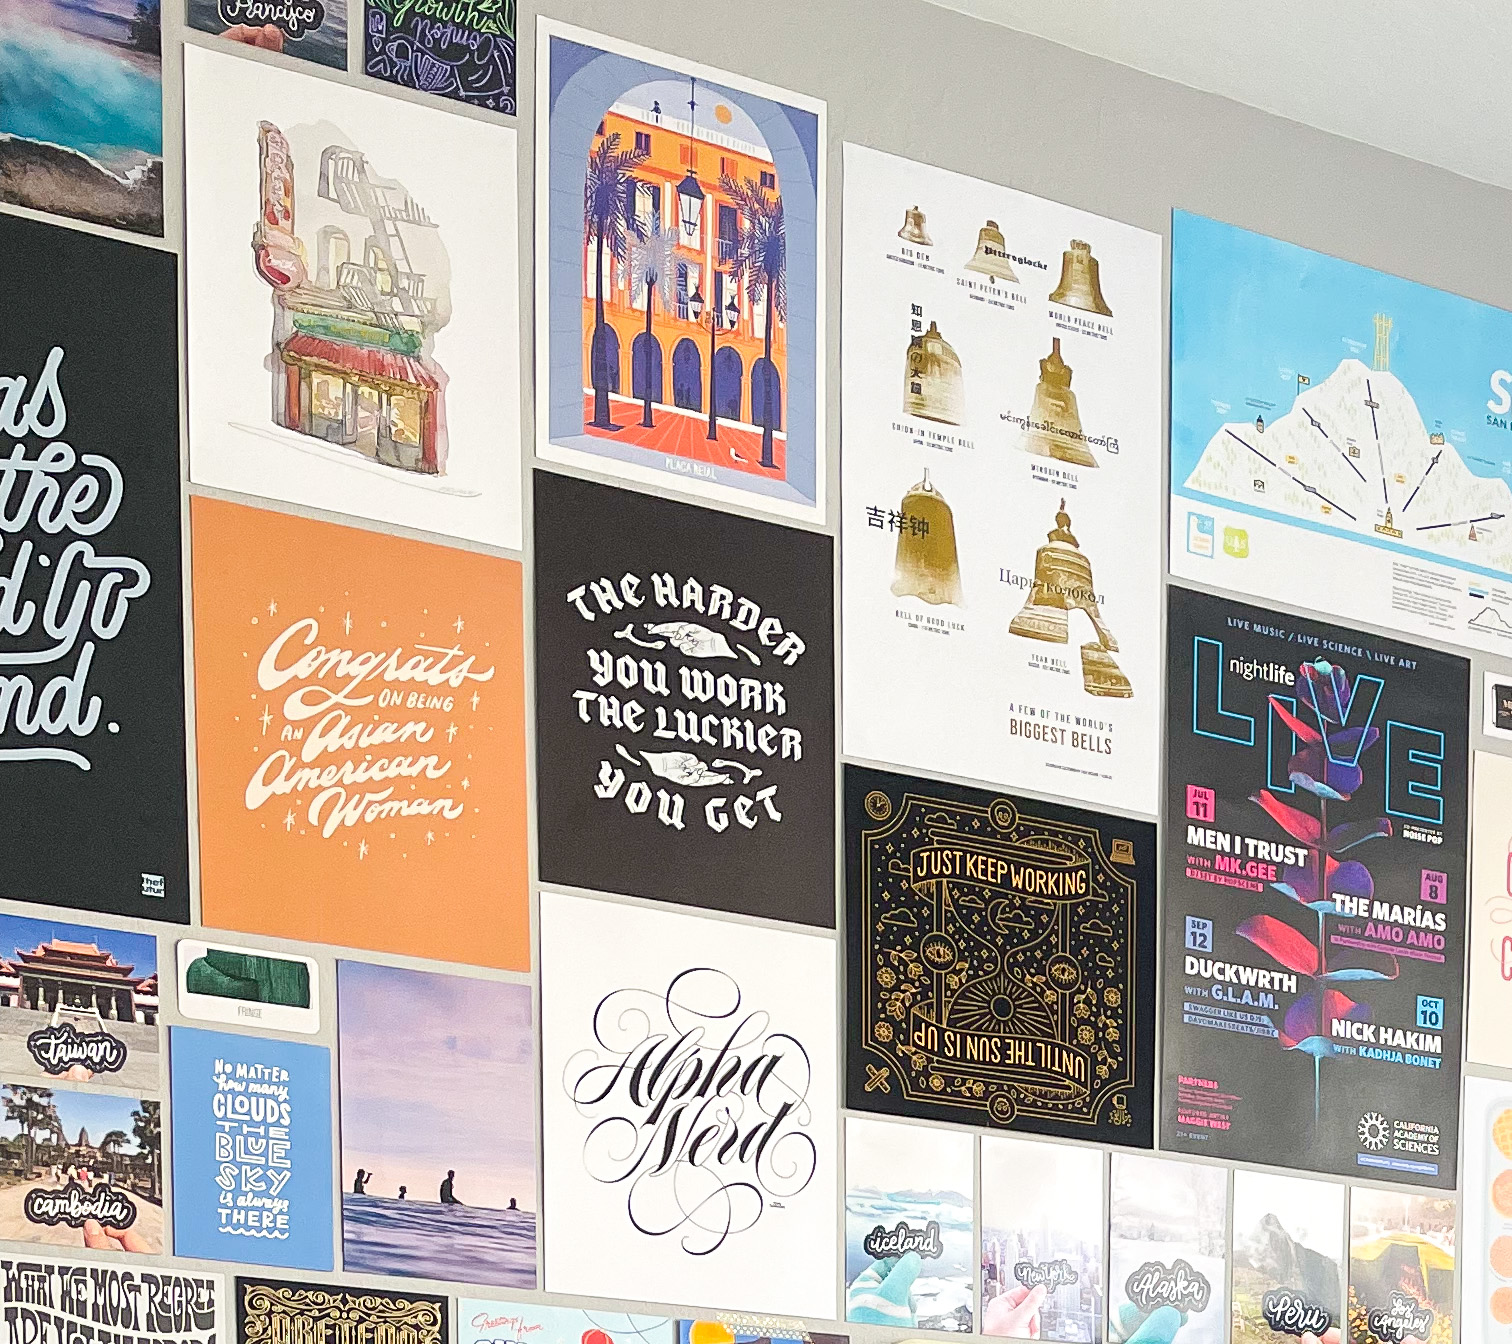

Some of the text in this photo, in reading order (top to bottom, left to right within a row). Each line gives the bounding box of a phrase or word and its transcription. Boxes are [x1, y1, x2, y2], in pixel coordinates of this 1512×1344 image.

[1486, 414, 1508, 431] SAN
[1226, 615, 1418, 670] LIVE MUSIC LIVE SCIENCE LIVE ART
[257, 617, 495, 721] Congrats
[587, 647, 788, 716] YOU WORK
[1229, 656, 1295, 687] nightlife
[378, 688, 455, 713] ON BEING
[1018, 704, 1036, 716] FEW
[1055, 711, 1071, 724] THE
[301, 709, 434, 763] Asian
[1010, 718, 1112, 755] BIGGEST BELLS
[1193, 635, 1445, 825] LIVE
[245, 749, 452, 810] American
[594, 760, 686, 830] YOU
[1192, 789, 1210, 801] JUL
[1192, 801, 1208, 818] 11
[307, 786, 464, 839] Woman
[1187, 825, 1309, 868] MEN I TRUST
[917, 850, 1088, 897] JUST KEEP WORKING
[1186, 855, 1211, 868] WITH
[1215, 854, 1278, 882] MK.GEE
[1425, 873, 1444, 884] AUG
[1429, 885, 1439, 900] 8
[1191, 919, 1208, 930] SEP
[1331, 892, 1447, 932] THE MARÍAS
[1190, 931, 1208, 949] 12
[1338, 924, 1362, 935] WITH
[1364, 922, 1404, 943] AMO
[1406, 930, 1446, 951] AMO
[1185, 955, 1298, 994] DUCKWRTH
[1184, 984, 1279, 1010] WITH G.L.A.M.
[1421, 999, 1440, 1010] OCT
[1420, 1009, 1440, 1027] 10
[1331, 1018, 1442, 1054] NICK HAKIM
[913, 1022, 1086, 1083] UNTIL THE SUN IS UP
[1333, 1043, 1442, 1069] WITH KADHJA BONET
[236, 1062, 290, 1083] MATTER
[212, 1073, 291, 1102] how many
[212, 1092, 292, 1127] CLOUDS
[215, 1120, 290, 1140] THE
[1393, 1120, 1440, 1135] CALIFORNIA
[1393, 1129, 1428, 1142] ACADEMY
[215, 1131, 292, 1169] BLUE
[1393, 1140, 1440, 1156] SCIENCES
[214, 1162, 292, 1197] SKY
[219, 1190, 290, 1214] is always
[217, 1207, 290, 1229] THERE
[1, 1259, 216, 1334] WHAT WE MOST REGRET
[1132, 1266, 1207, 1307] Alaska
[1268, 1295, 1325, 1330] Peru
